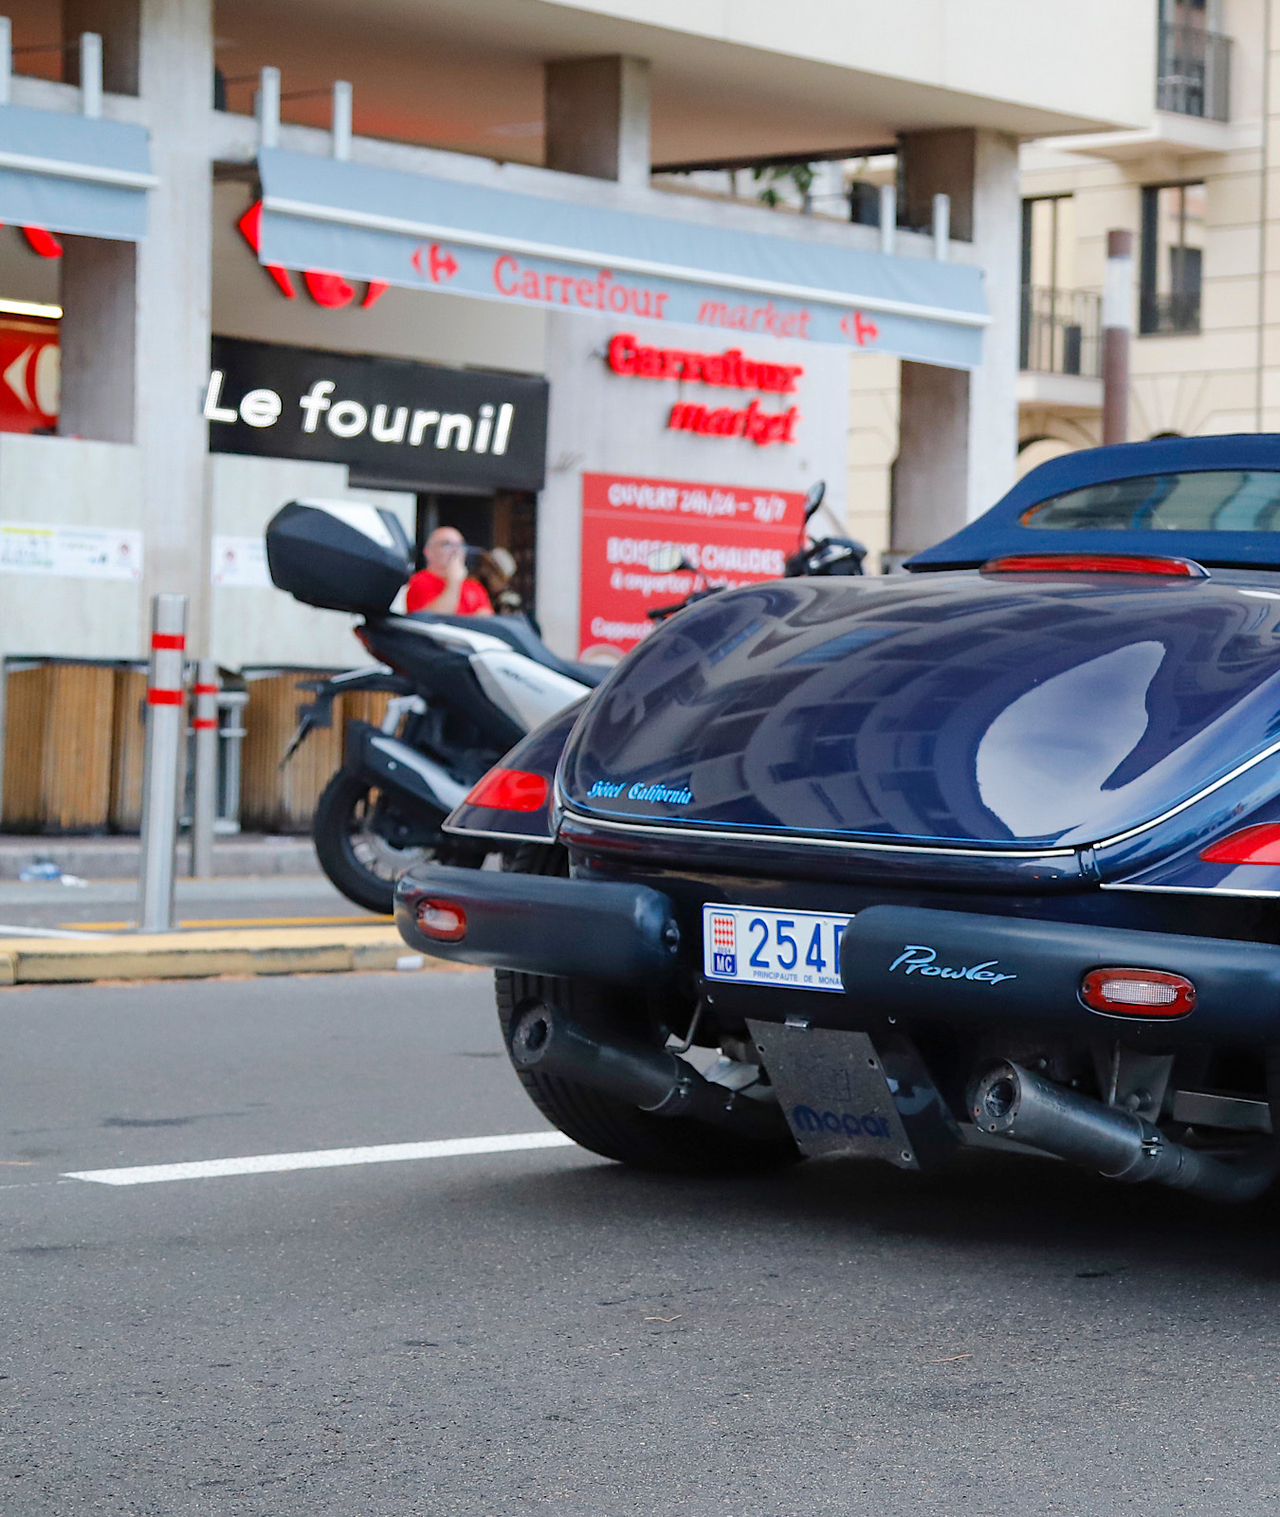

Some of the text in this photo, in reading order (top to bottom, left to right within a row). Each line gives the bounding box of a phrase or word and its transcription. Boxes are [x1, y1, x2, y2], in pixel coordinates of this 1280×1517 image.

[492, 254, 811, 339] Carrefour market
[608, 332, 804, 393] Carrefour
[203, 369, 515, 456] Le fournil
[668, 397, 800, 448] market
[608, 483, 678, 512] OUVERT
[627, 781, 694, 805] California
[716, 955, 732, 972] MC
[888, 944, 1018, 986] Prowler
